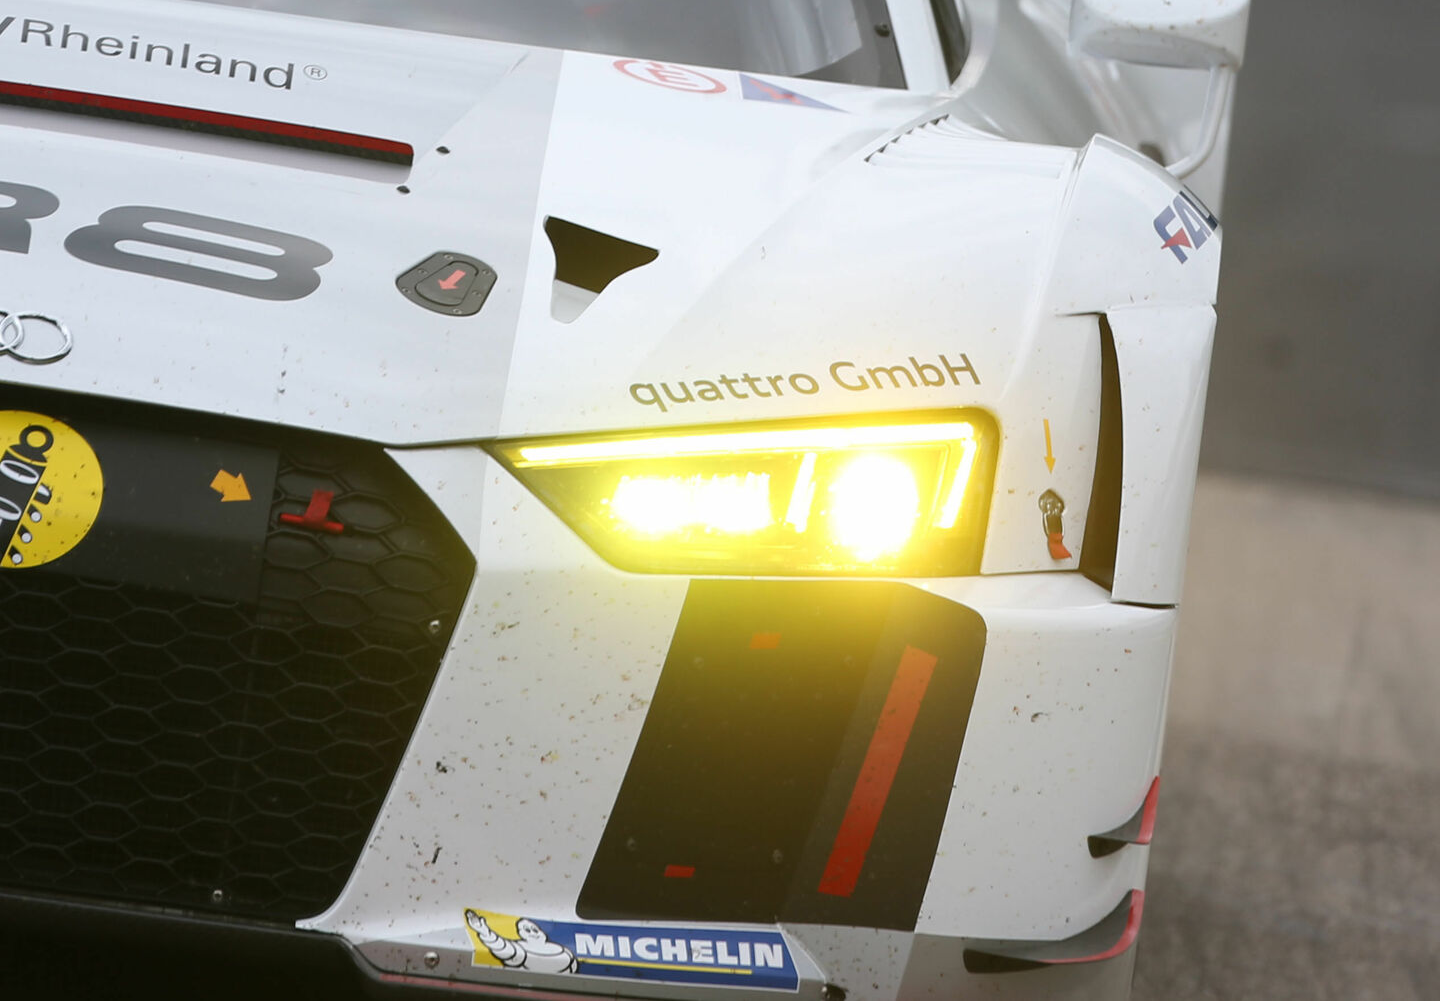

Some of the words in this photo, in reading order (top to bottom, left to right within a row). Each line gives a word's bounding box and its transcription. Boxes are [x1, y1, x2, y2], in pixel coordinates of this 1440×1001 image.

[629, 373, 820, 412] quattro
[829, 353, 981, 391] GmbH
[575, 933, 785, 968] MICHELIN
